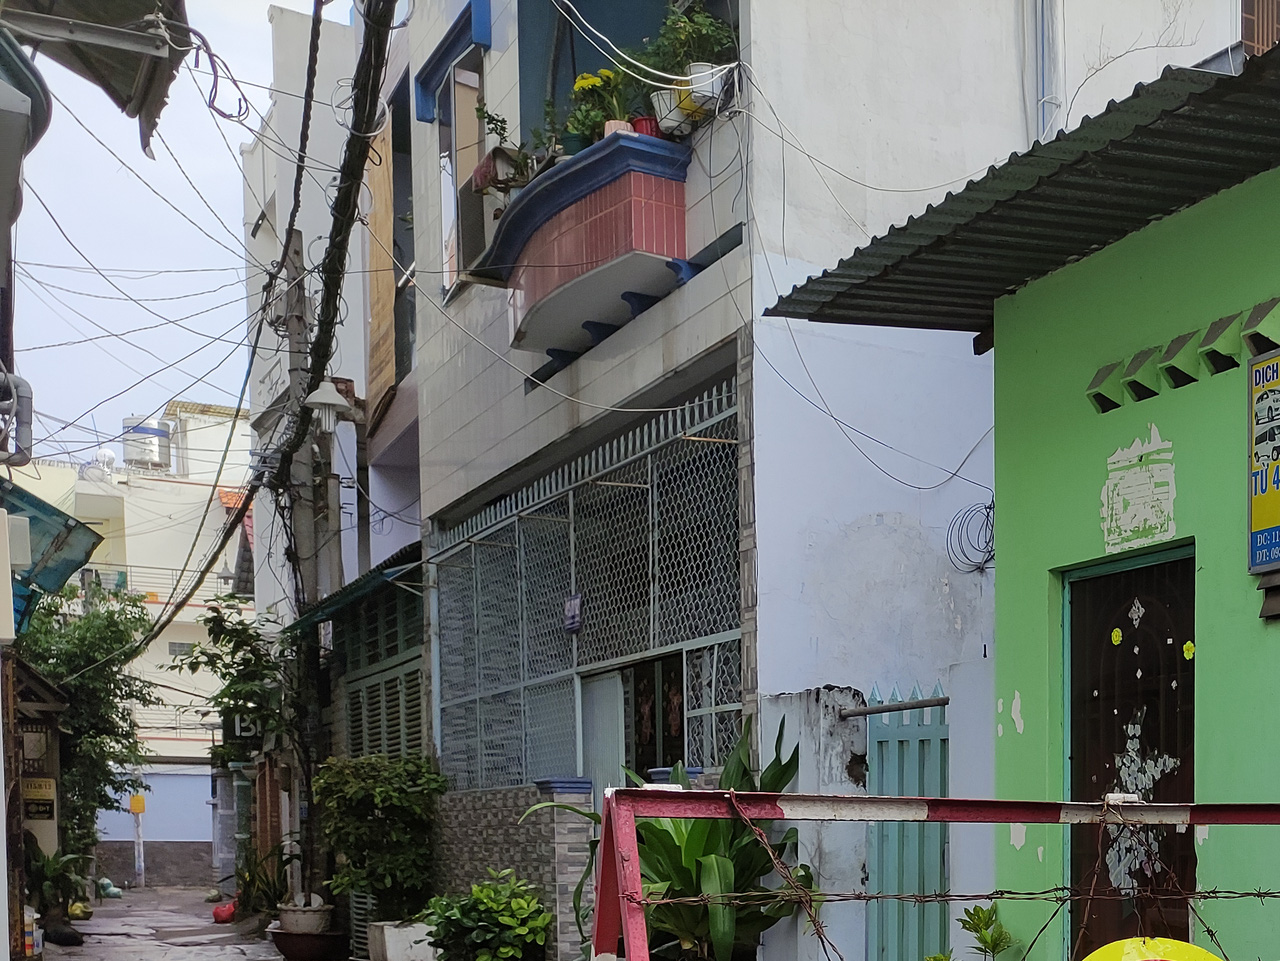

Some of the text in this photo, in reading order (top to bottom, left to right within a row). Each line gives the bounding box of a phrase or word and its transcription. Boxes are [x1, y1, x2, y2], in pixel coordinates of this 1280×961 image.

[1254, 362, 1279, 389] DỊCH
[1251, 461, 1270, 496] TỪ
[1272, 464, 1280, 491] 4
